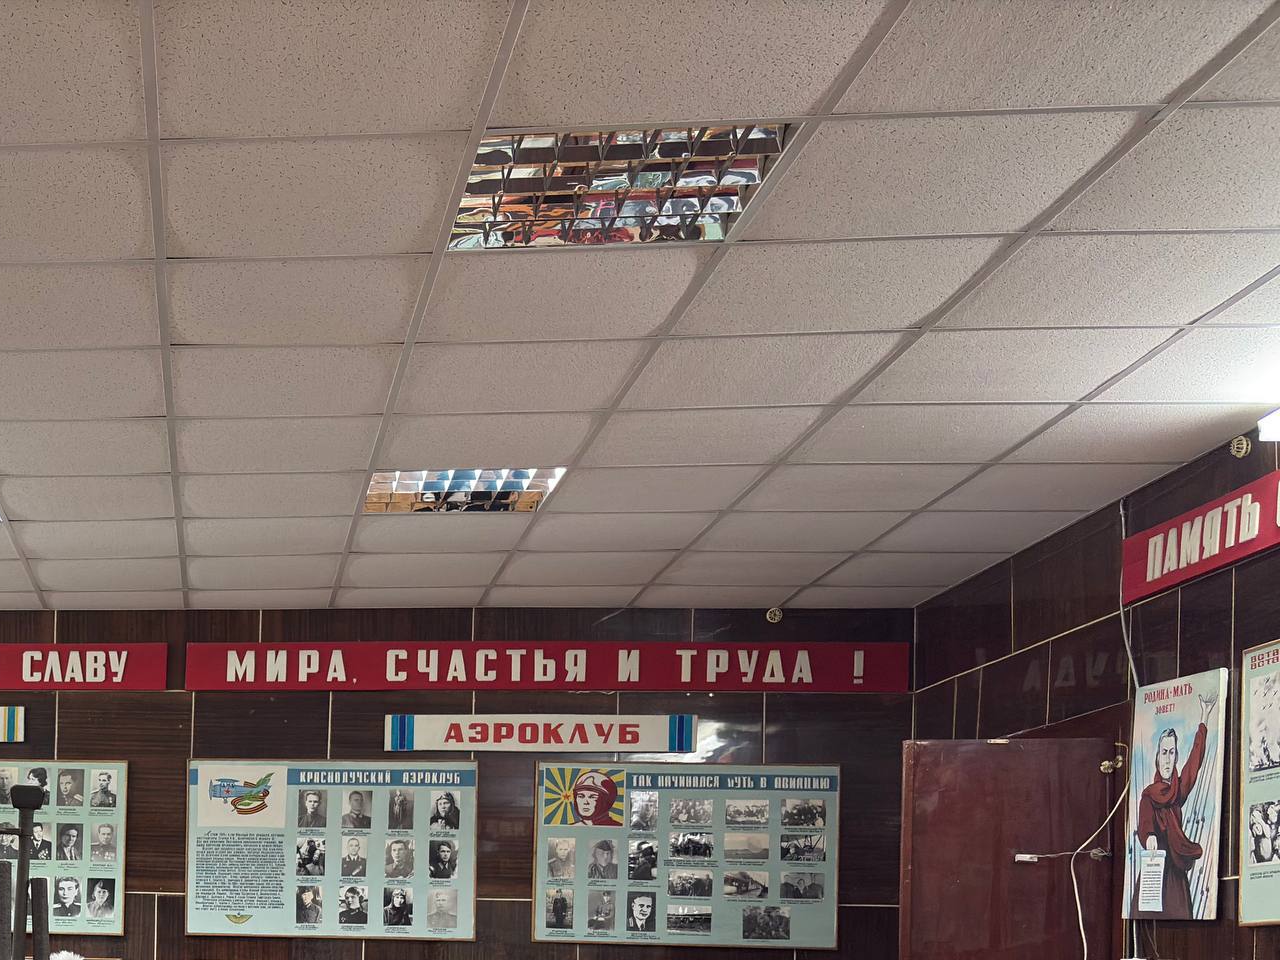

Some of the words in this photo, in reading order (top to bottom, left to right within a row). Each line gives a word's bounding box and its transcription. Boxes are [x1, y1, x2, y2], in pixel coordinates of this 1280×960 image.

[1146, 493, 1261, 582] ПАМЯТЬ
[22, 650, 129, 683] СЛАВУ
[226, 649, 358, 685] МИРА,
[385, 649, 587, 682] СЧАСТЬЯ
[617, 649, 641, 682] И
[675, 649, 814, 684] ТРУДА
[443, 722, 640, 745] АЭРОКЛУБ
[299, 770, 391, 784] КРАСНОЛУЧСКИЙ
[402, 771, 461, 785] АЭРОКЛУБ
